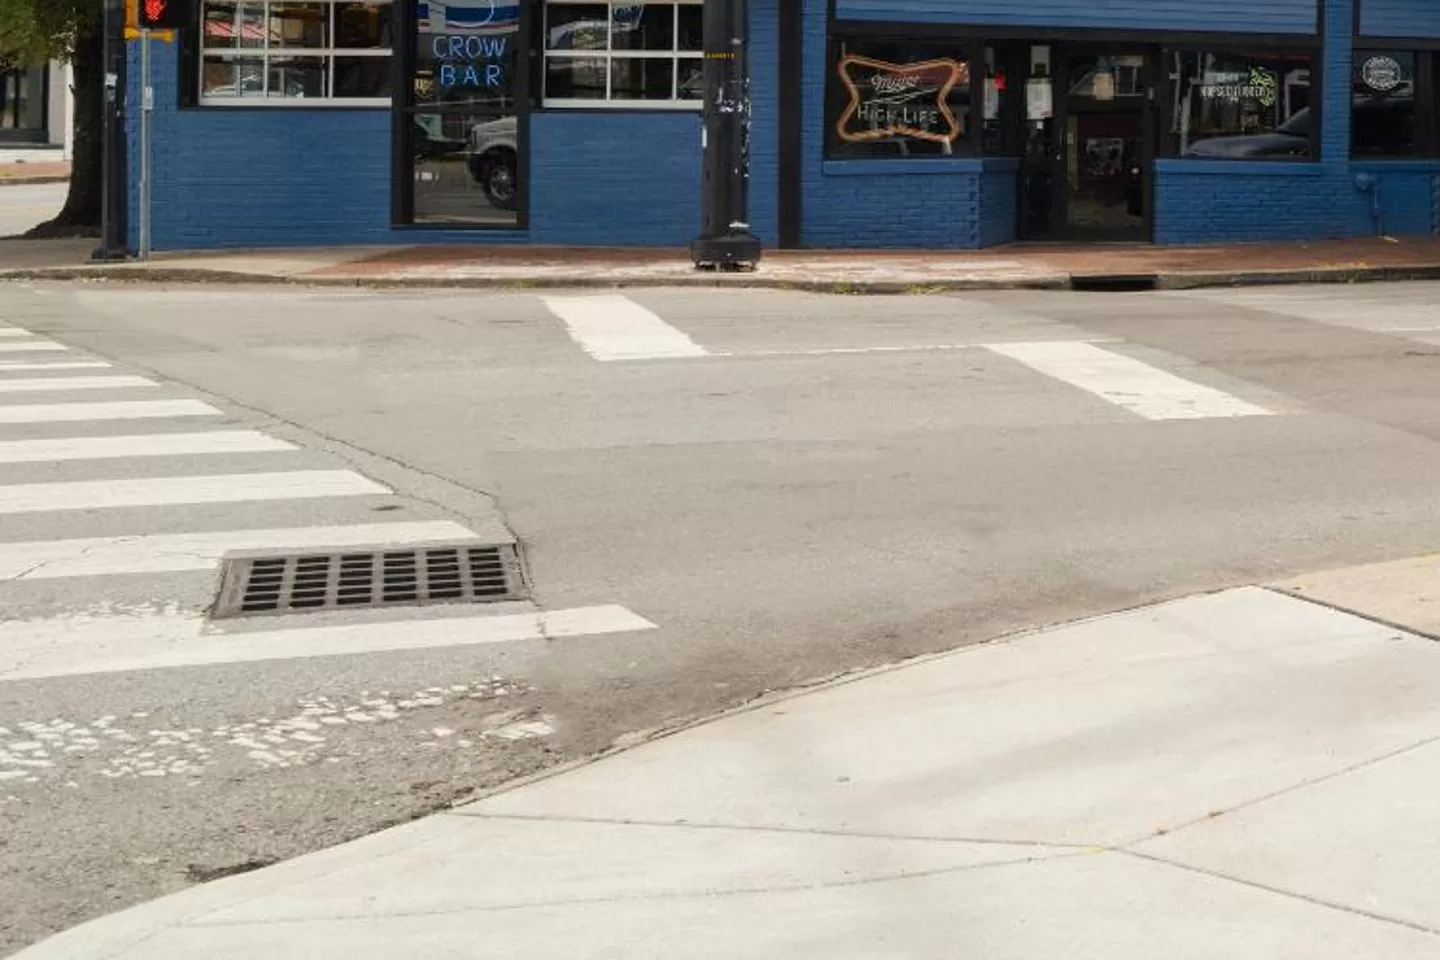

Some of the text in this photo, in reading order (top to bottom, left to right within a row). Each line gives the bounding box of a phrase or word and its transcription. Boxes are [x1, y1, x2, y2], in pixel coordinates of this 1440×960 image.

[432, 35, 506, 59] CROW
[440, 64, 501, 86] BAR
[903, 106, 938, 124] LIFE
